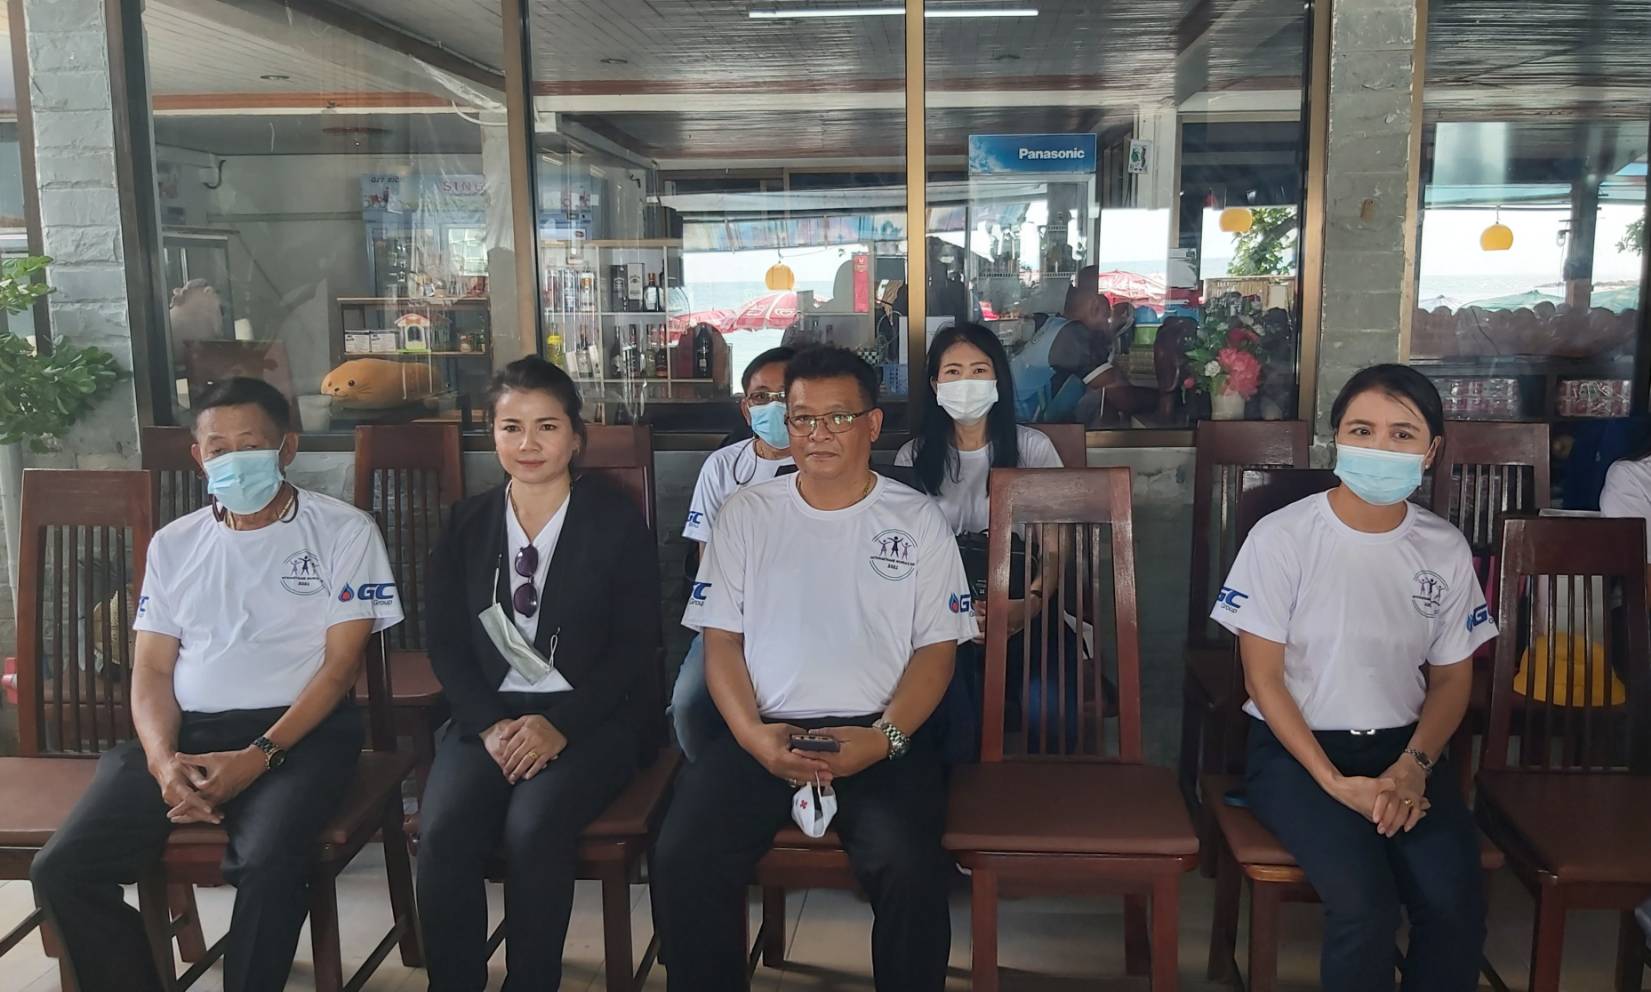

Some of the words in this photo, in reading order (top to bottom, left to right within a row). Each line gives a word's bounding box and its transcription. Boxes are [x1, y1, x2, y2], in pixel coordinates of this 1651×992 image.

[1019, 147, 1085, 160] Panasonic
[357, 582, 396, 601] GC
[691, 582, 712, 600] C
[960, 594, 976, 613] G
